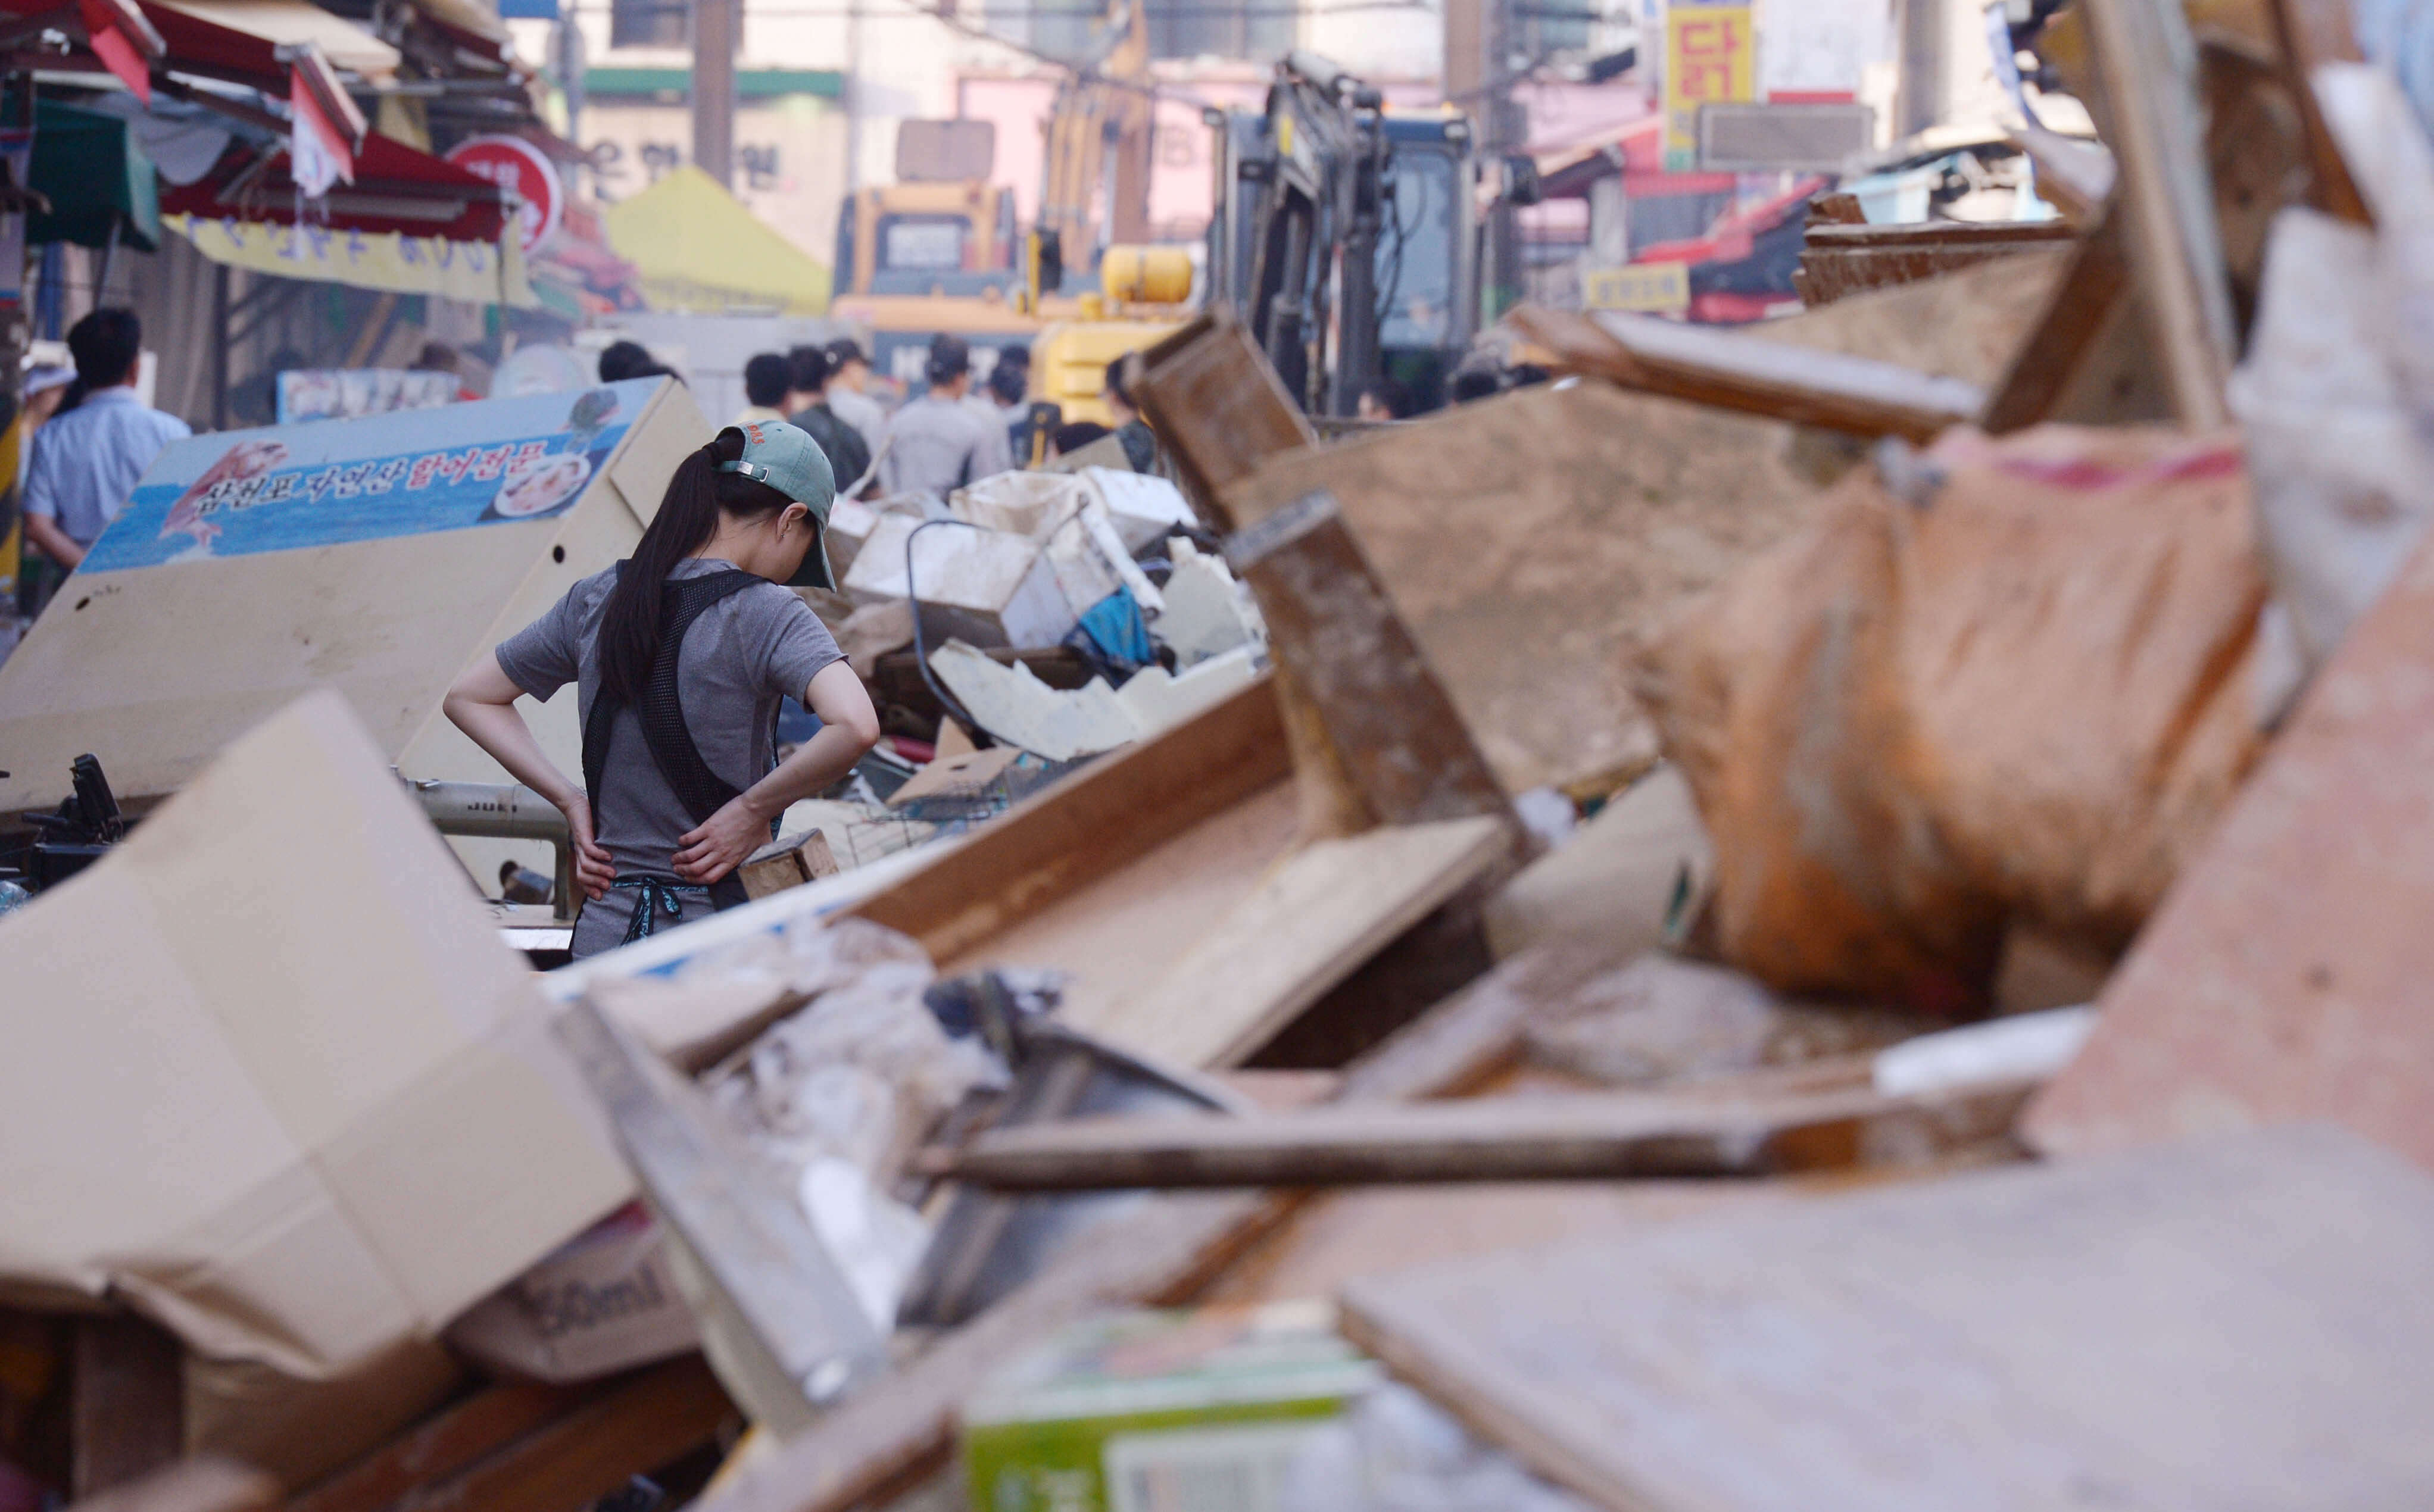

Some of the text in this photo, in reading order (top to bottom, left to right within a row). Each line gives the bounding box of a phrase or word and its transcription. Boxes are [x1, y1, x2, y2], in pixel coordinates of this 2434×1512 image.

[197, 443, 545, 517] 삼천포 자연산 활어전문
